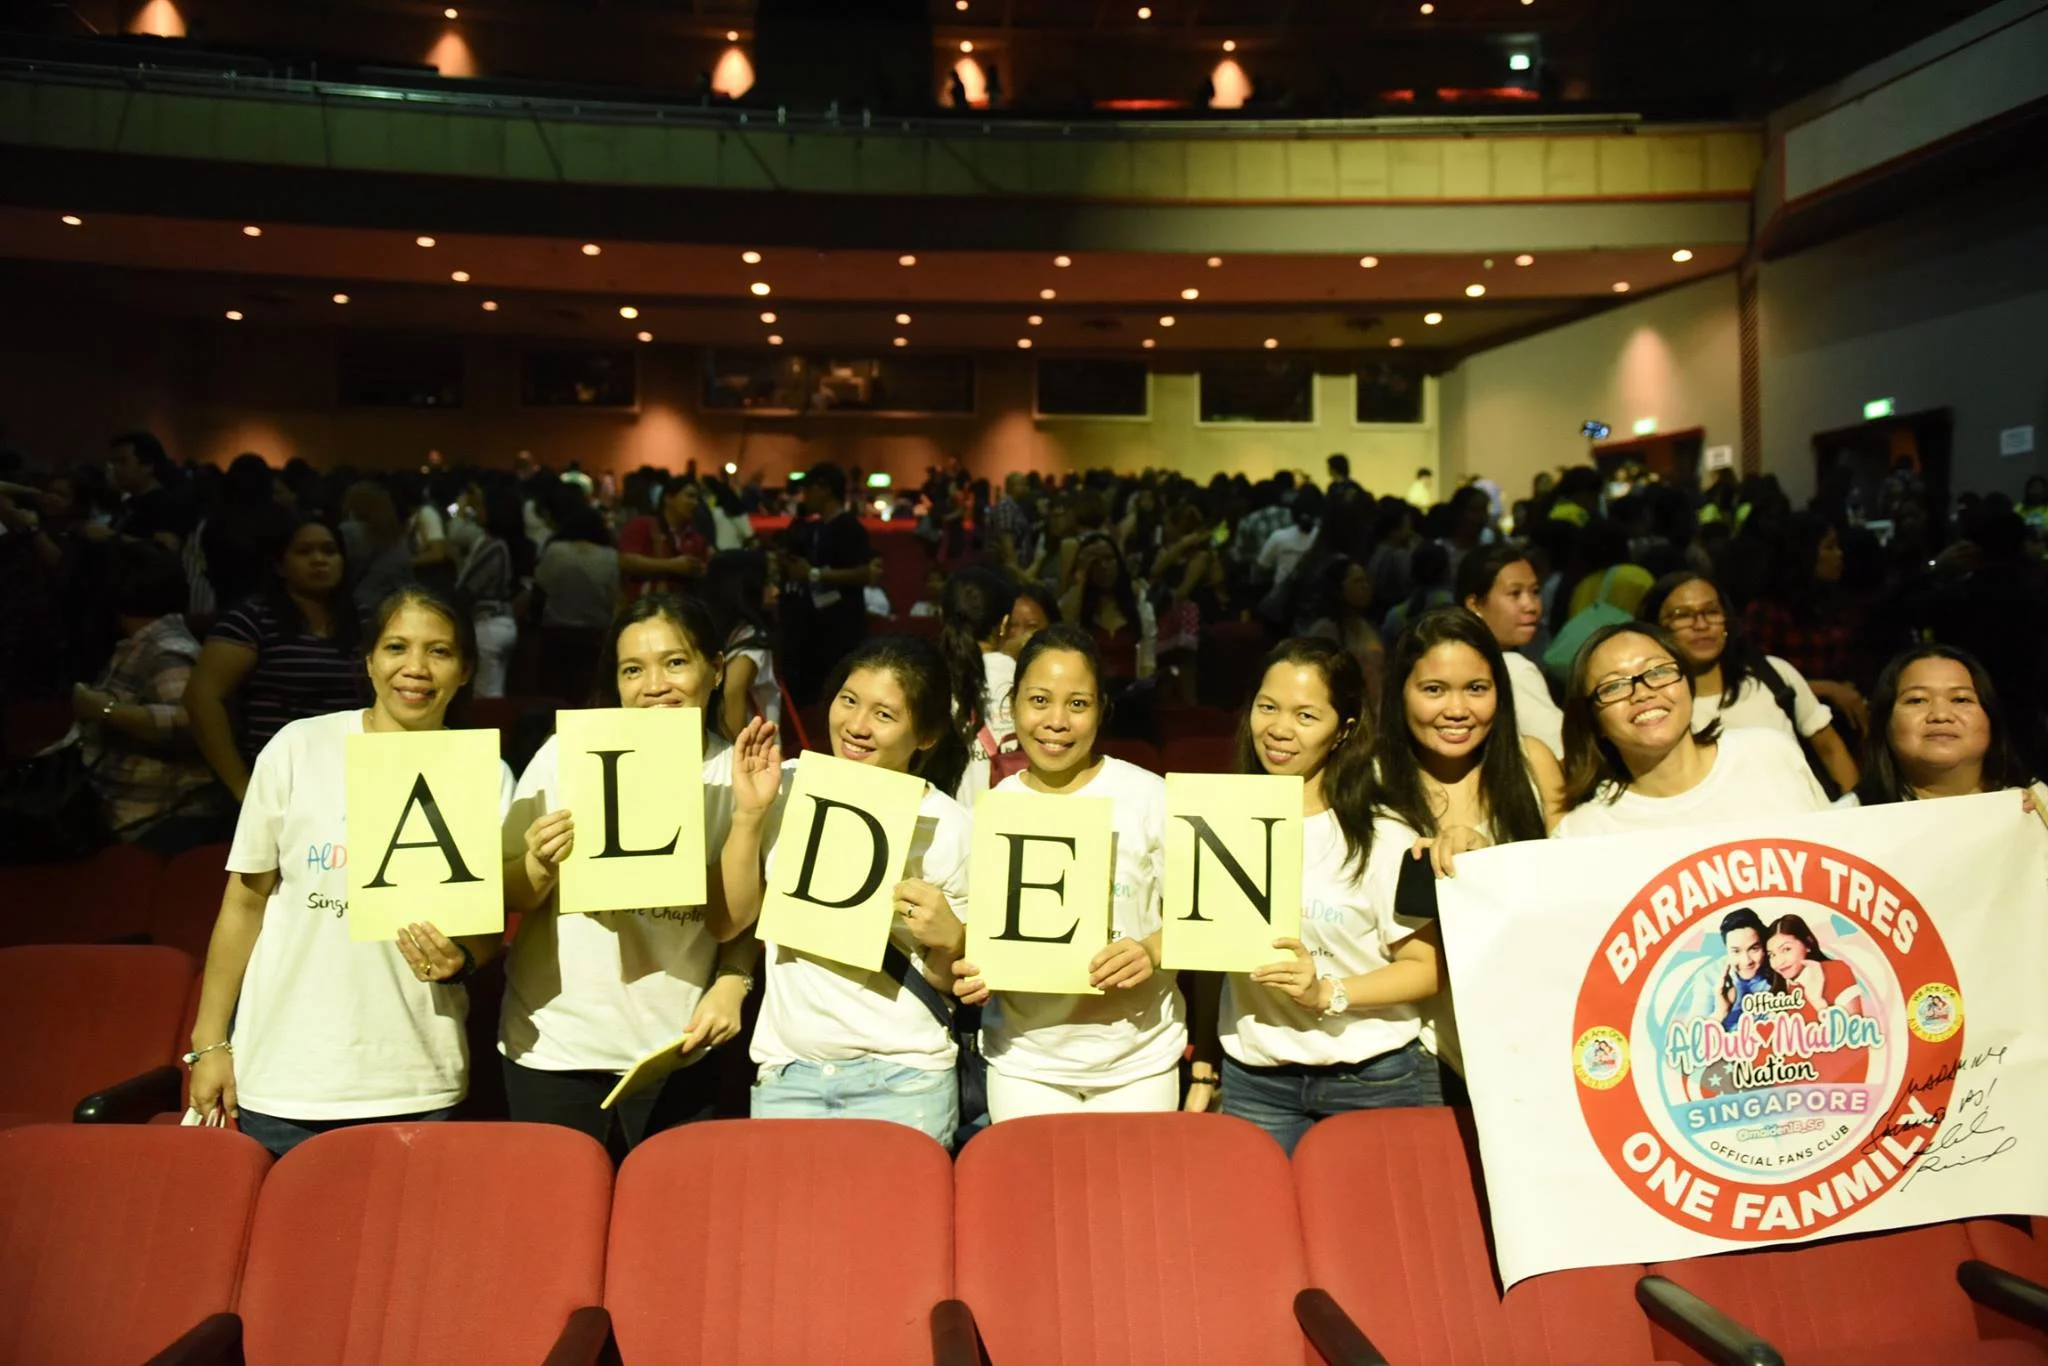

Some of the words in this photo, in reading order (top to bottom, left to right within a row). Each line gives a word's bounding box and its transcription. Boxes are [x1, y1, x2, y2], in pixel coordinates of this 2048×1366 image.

[361, 772, 485, 890] A
[587, 749, 682, 860] L
[783, 793, 890, 909] D
[989, 832, 1080, 944] E
[1173, 815, 1287, 926] N
[1605, 847, 1808, 985] BARANGAY
[1820, 856, 1919, 955] TRES
[1670, 1015, 1757, 1070] AlDub
[1776, 1008, 1883, 1056] MaiDen
[1743, 989, 1803, 1012] Official
[1688, 1091, 1868, 1129] SINGAPORE
[1735, 1060, 1816, 1087] Nation
[1622, 1131, 1721, 1223] ONE
[1730, 1095, 1934, 1232] FANMILY
[1710, 1140, 1773, 1167] OFFICIAL
[1778, 1147, 1814, 1166] FANS
[1817, 1124, 1850, 1151] CLUB
